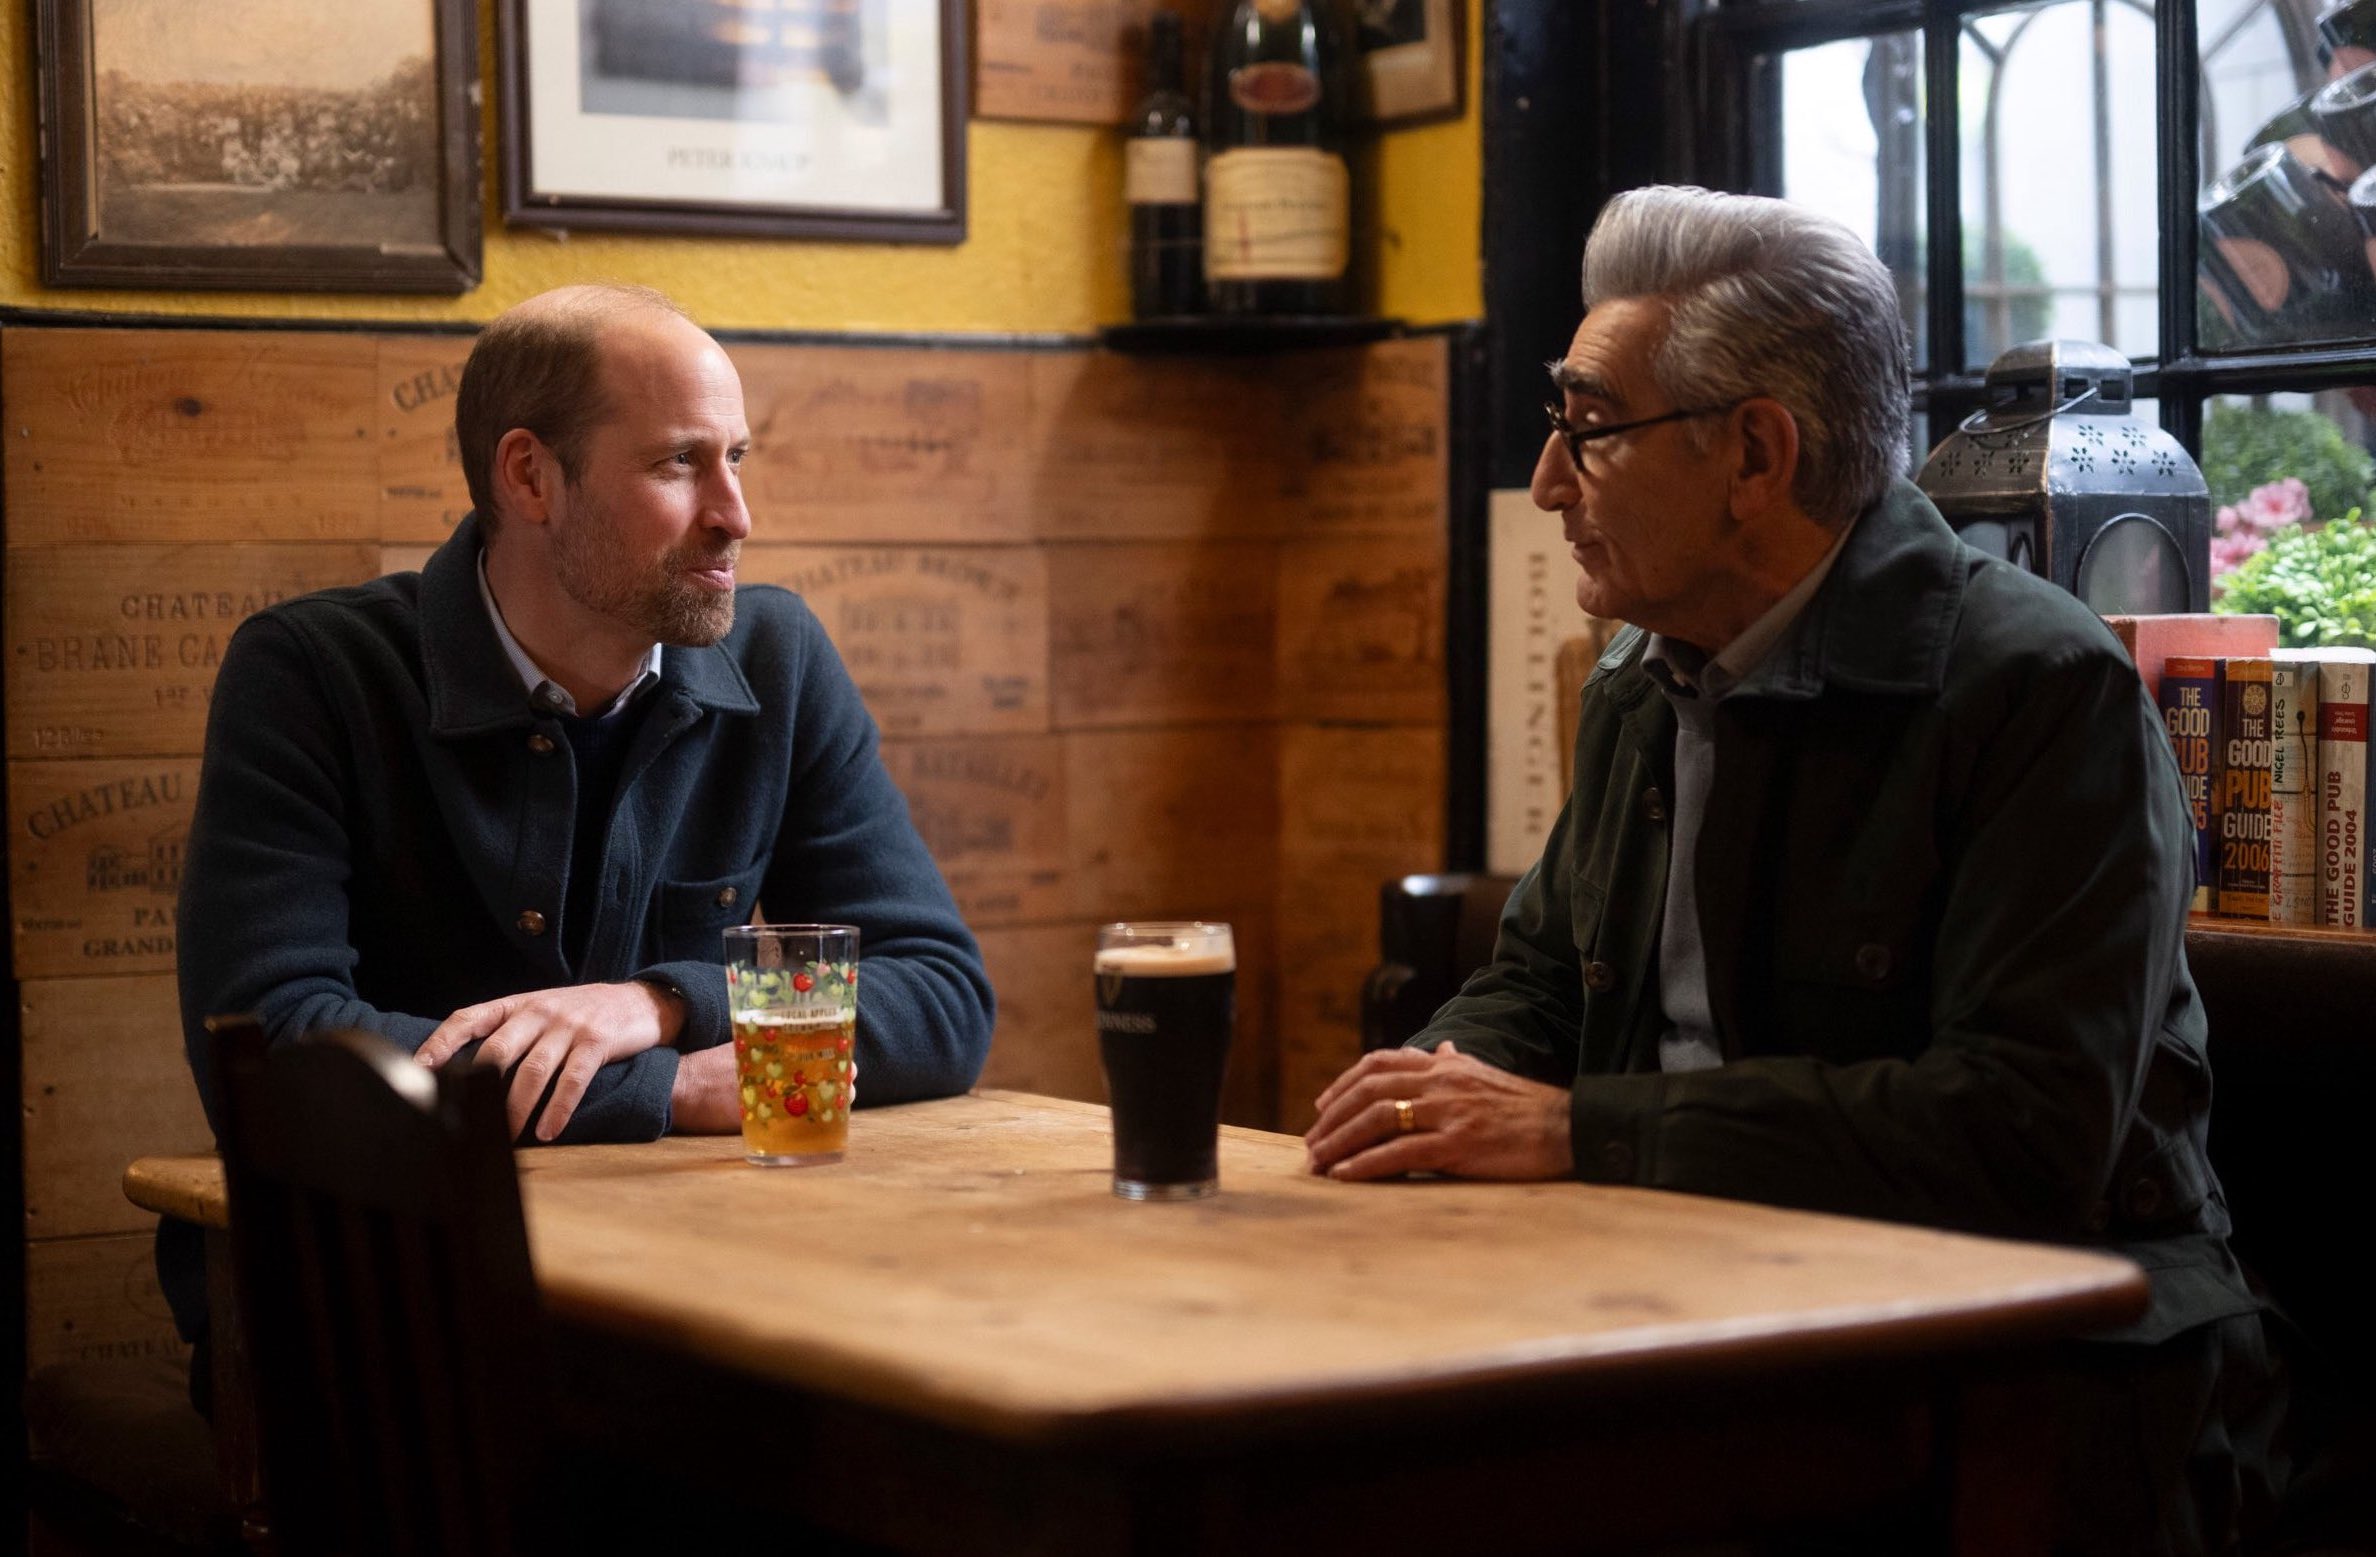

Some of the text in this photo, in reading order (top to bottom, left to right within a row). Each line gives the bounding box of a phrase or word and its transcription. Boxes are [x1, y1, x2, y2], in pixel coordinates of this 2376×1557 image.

[2179, 686, 2202, 706] THE
[2166, 706, 2210, 737] GOOD
[2242, 718, 2264, 738] THE
[2227, 739, 2271, 768] GOOD
[2273, 699, 2286, 784] NIGEL REES
[2225, 770, 2271, 810] PUB
[27, 772, 182, 840] CHATEAU
[2223, 812, 2271, 839] GUIDE
[2224, 842, 2271, 869] 2006
[2325, 770, 2342, 927] THE GOOD PUB
[2343, 809, 2358, 927] GUIDE 2004
